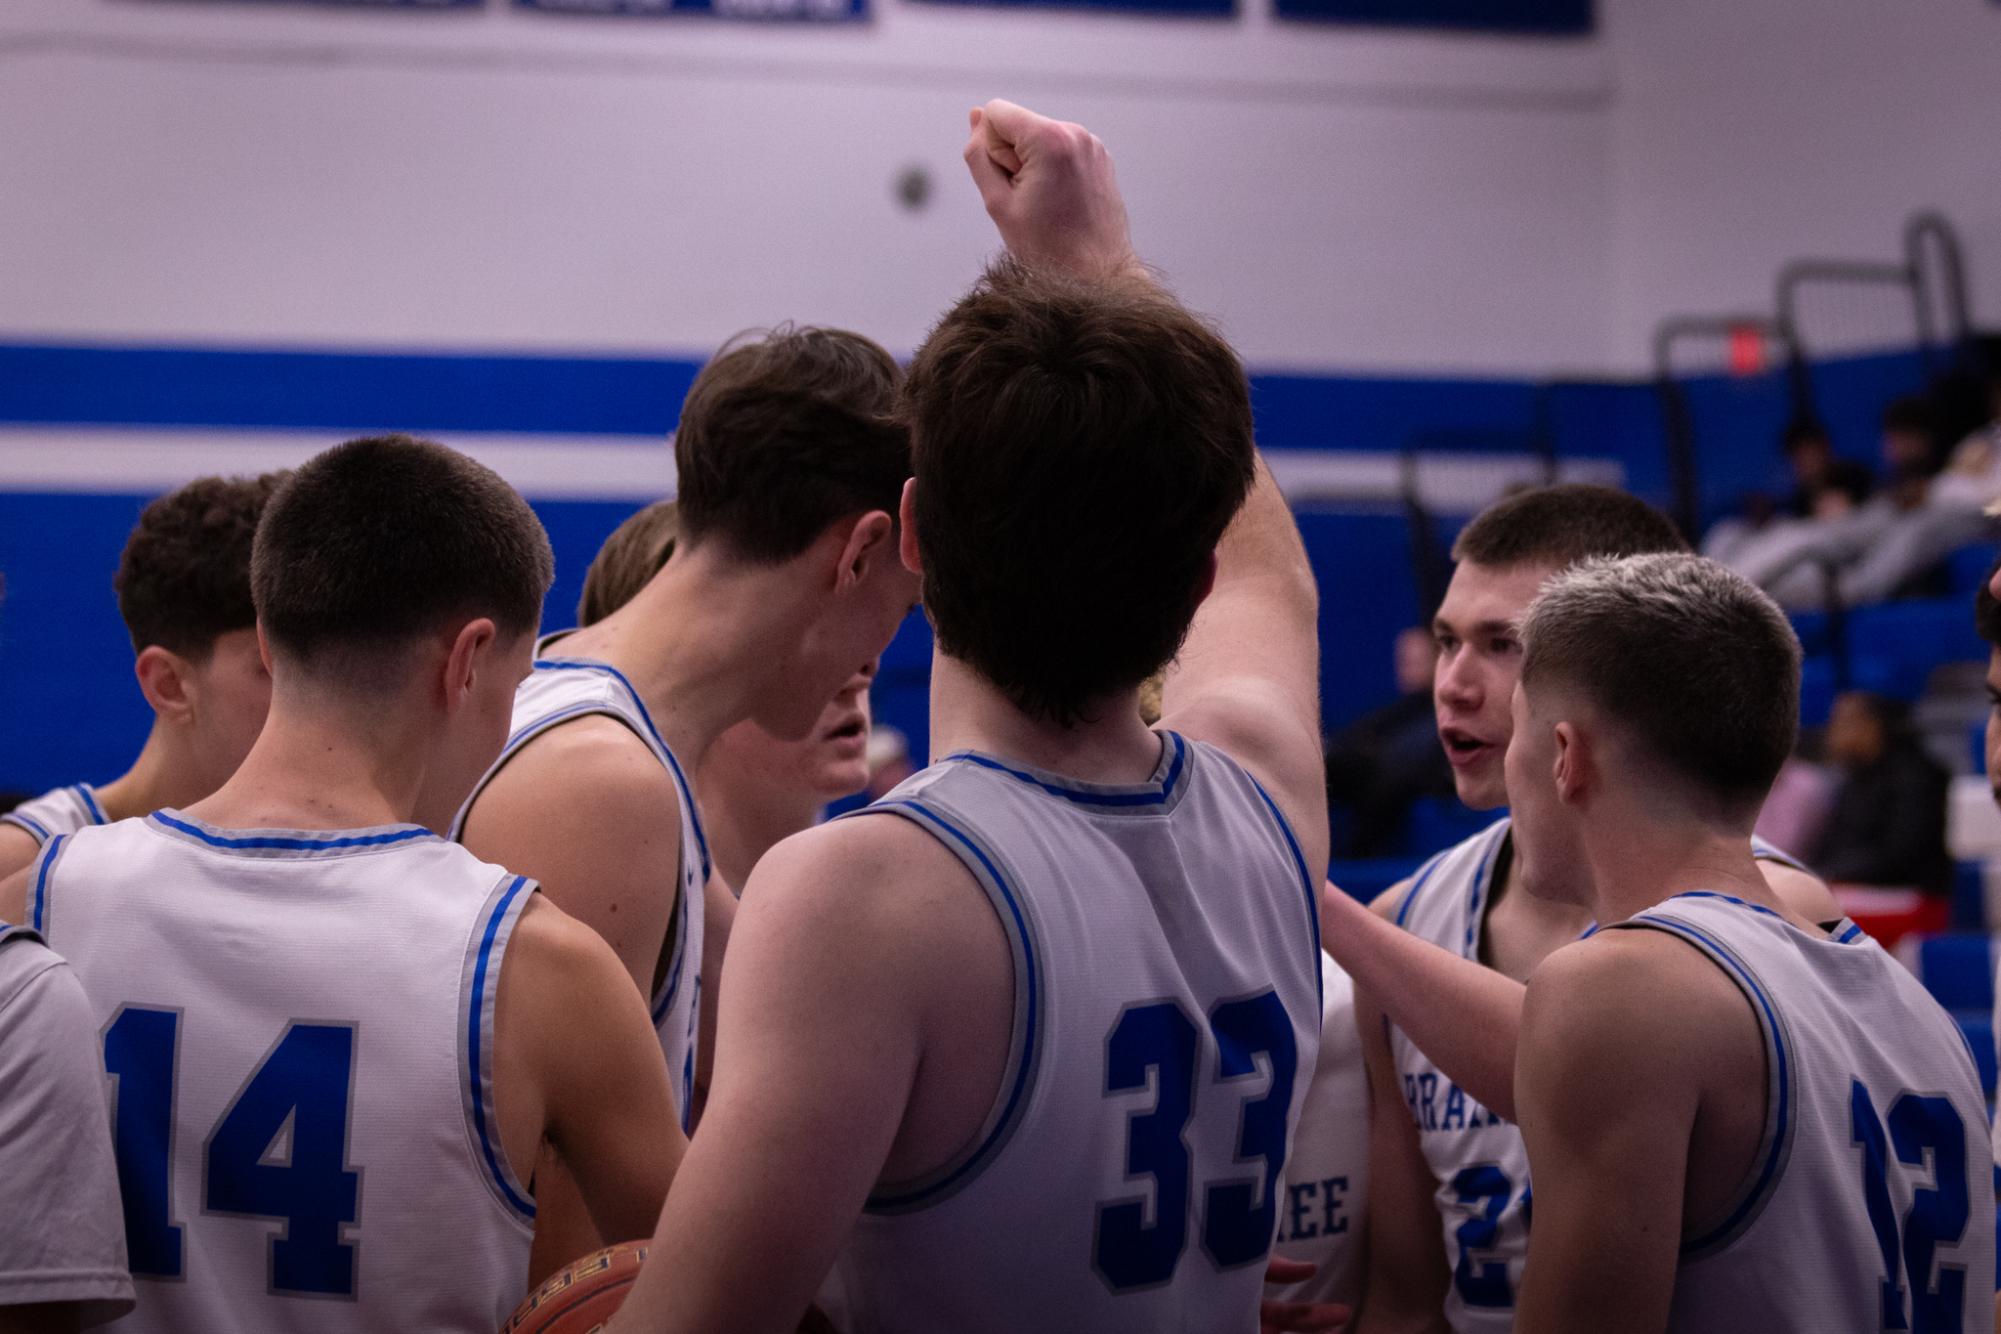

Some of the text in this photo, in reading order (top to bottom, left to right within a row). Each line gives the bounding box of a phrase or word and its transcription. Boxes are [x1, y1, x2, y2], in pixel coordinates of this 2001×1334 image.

[100, 1001, 365, 1302] 14
[1092, 984, 1299, 1296] 33
[1277, 1176, 1349, 1242] EE
[1848, 1073, 1970, 1334] 12
